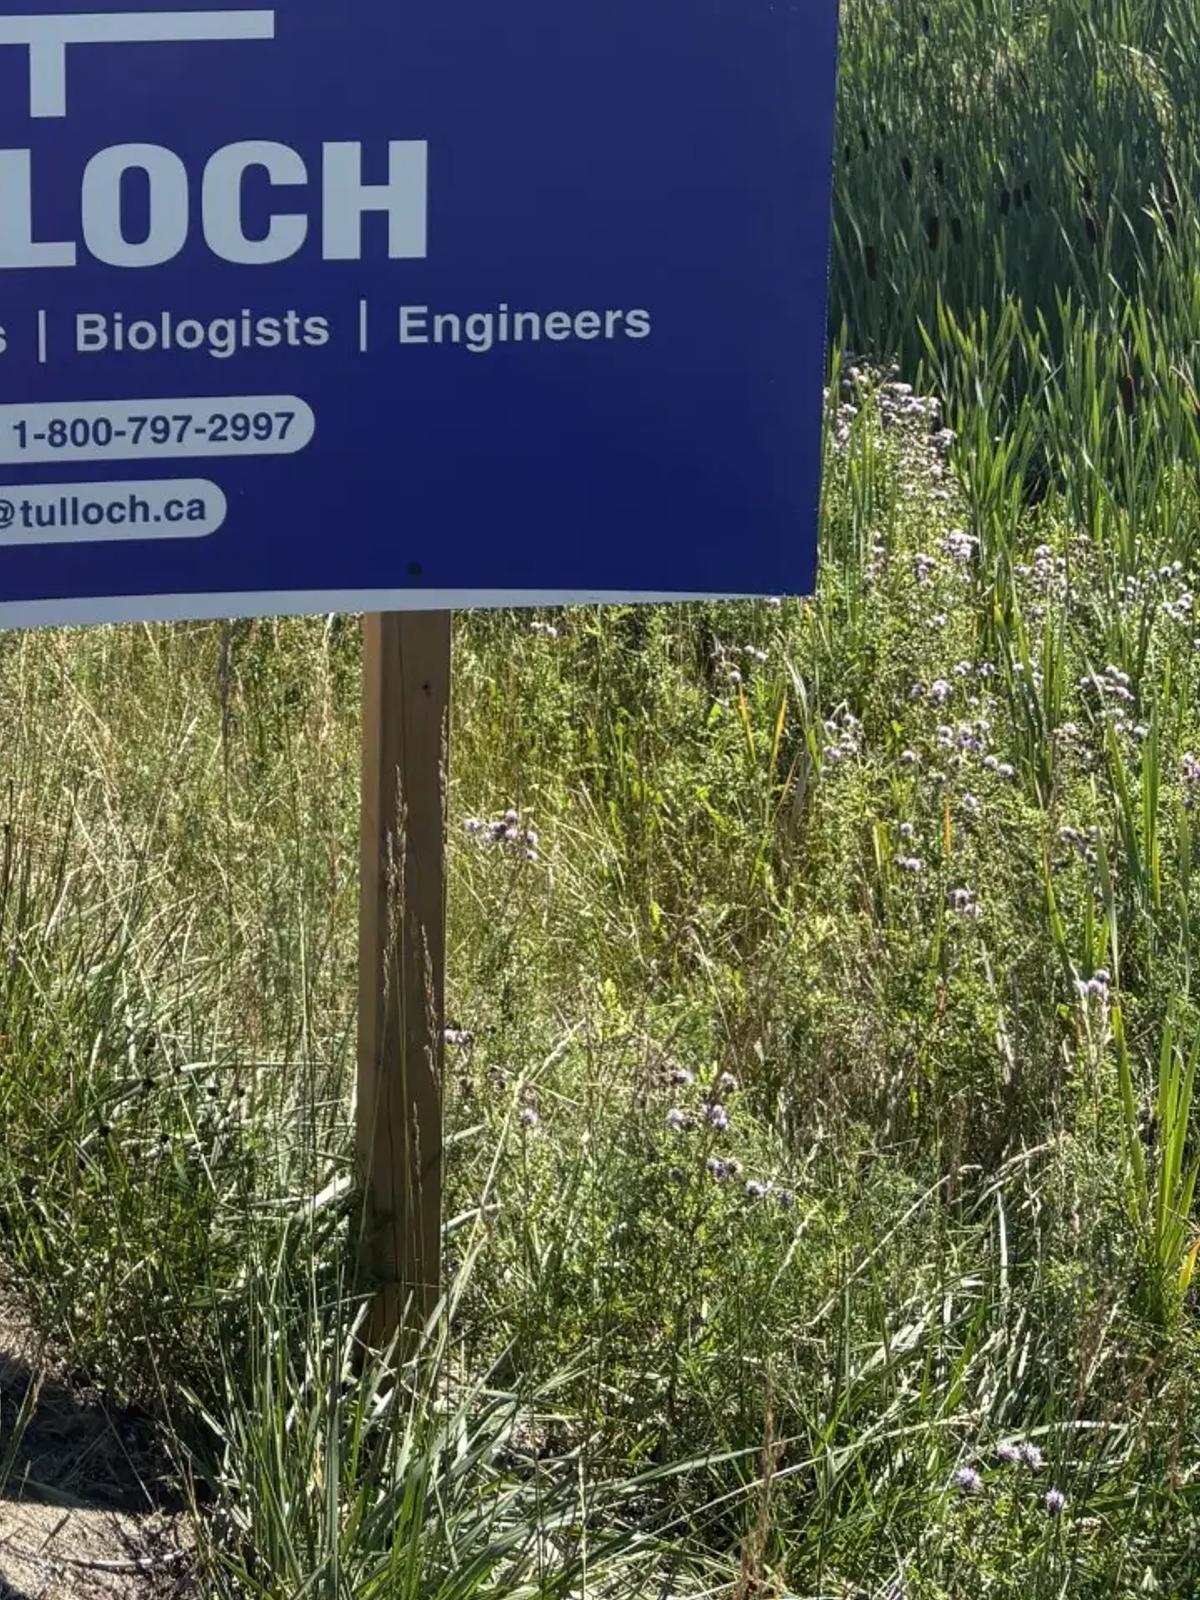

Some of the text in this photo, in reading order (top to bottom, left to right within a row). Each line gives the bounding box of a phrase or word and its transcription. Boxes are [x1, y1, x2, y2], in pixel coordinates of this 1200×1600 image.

[77, 309, 329, 358] Biologists
[400, 304, 650, 352] Engineers
[13, 412, 296, 449] 1-800-797-2997
